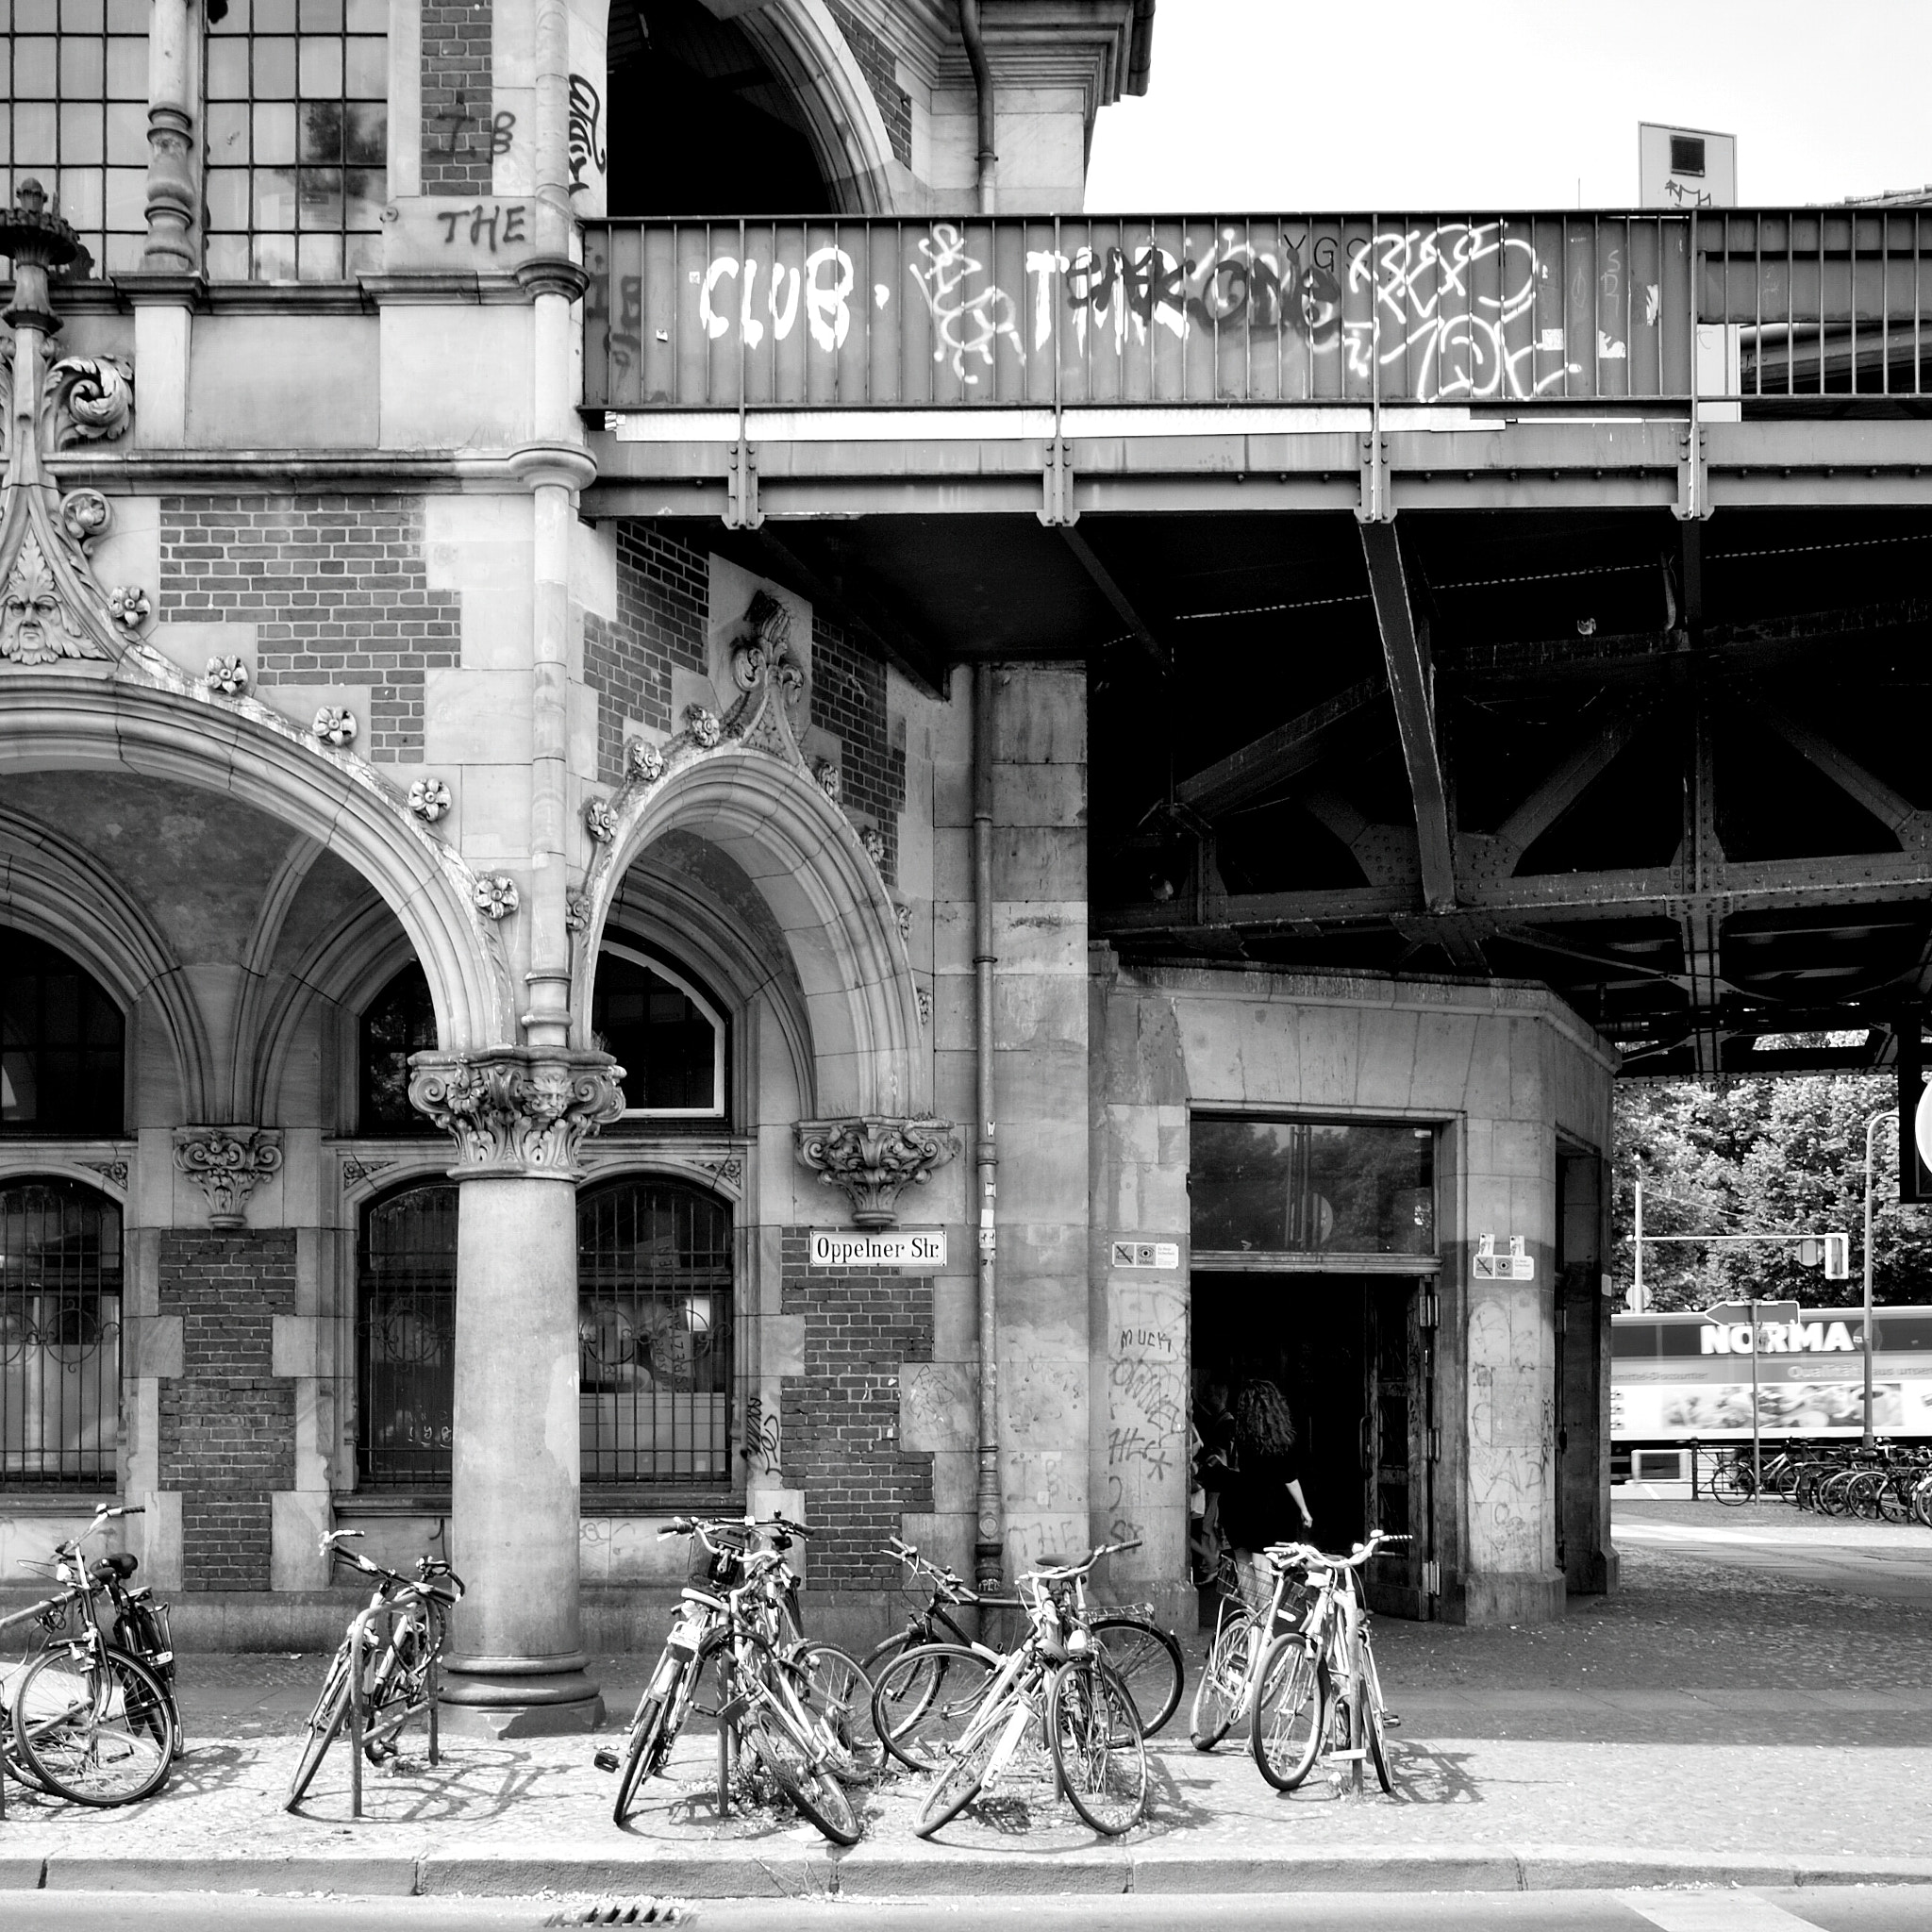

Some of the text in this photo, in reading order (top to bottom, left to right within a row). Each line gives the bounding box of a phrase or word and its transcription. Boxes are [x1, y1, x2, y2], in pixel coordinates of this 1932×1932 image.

[437, 204, 525, 254] THE
[699, 246, 854, 353] CLUB
[817, 1237, 940, 1264] Oppelner Str.
[1701, 1322, 1855, 1354] NORMA
